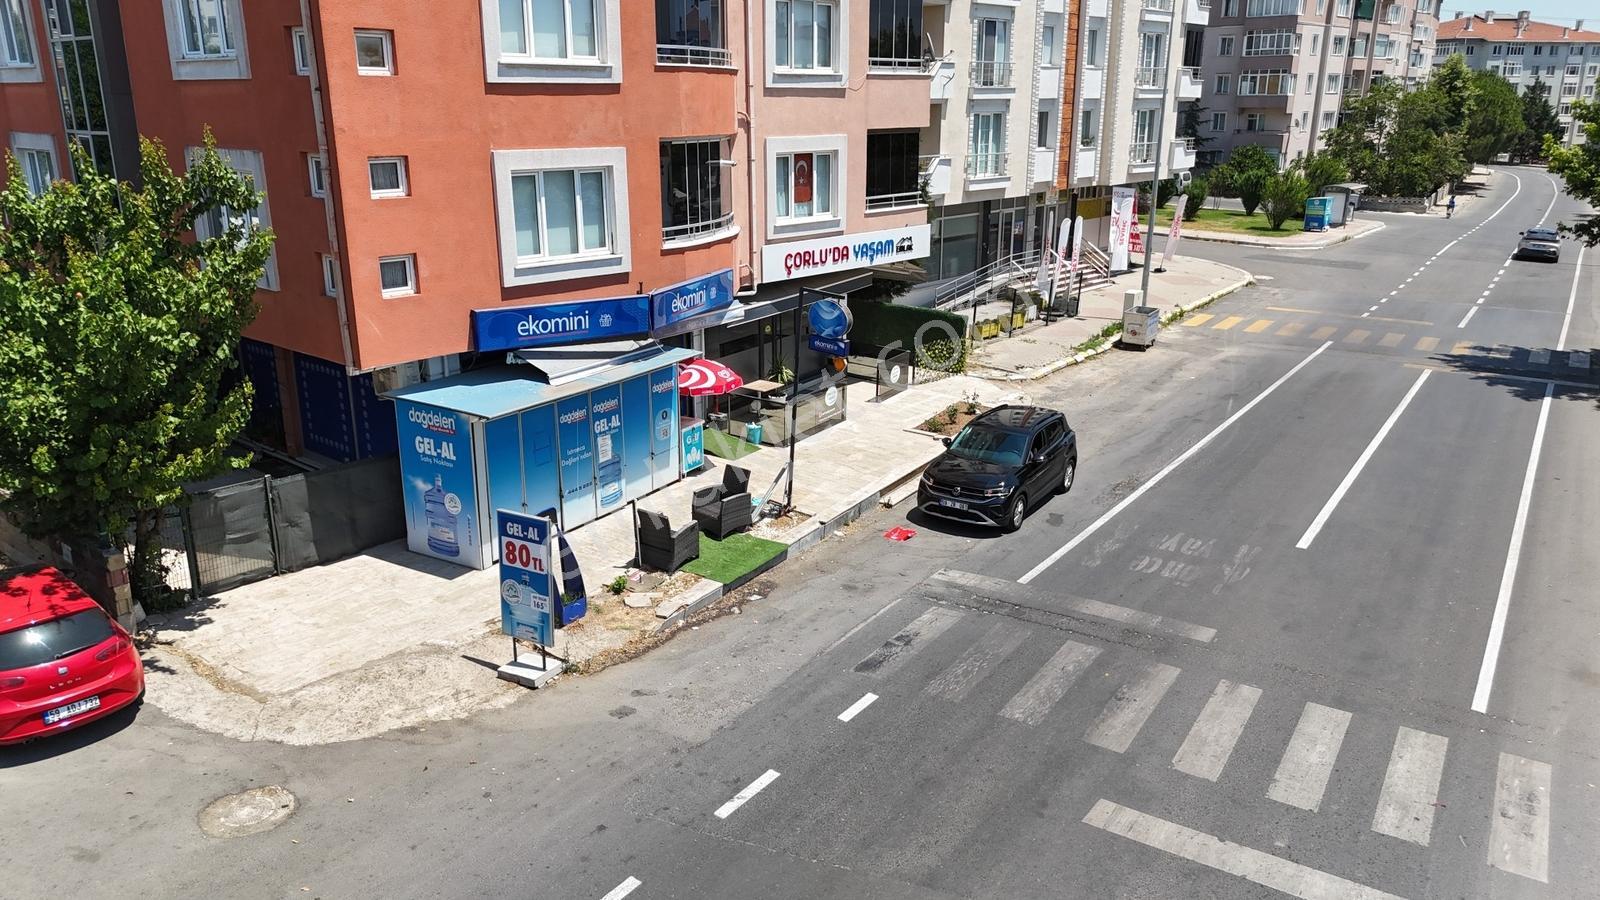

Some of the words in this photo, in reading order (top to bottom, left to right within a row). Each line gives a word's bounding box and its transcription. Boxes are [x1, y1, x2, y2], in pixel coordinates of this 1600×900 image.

[784, 245, 849, 275] ÇORLU'DA
[853, 239, 894, 263] YAŞAM
[671, 285, 706, 312] ekomini
[517, 310, 589, 336] ekomini
[814, 340, 835, 351] ekomini
[409, 406, 456, 430] dağdelen
[594, 414, 621, 434] GEL-AL
[415, 436, 456, 461] GEL-AL
[506, 521, 540, 541] GEL-AL
[505, 540, 531, 568] 80
[532, 556, 545, 572] TL
[533, 600, 545, 610] 165
